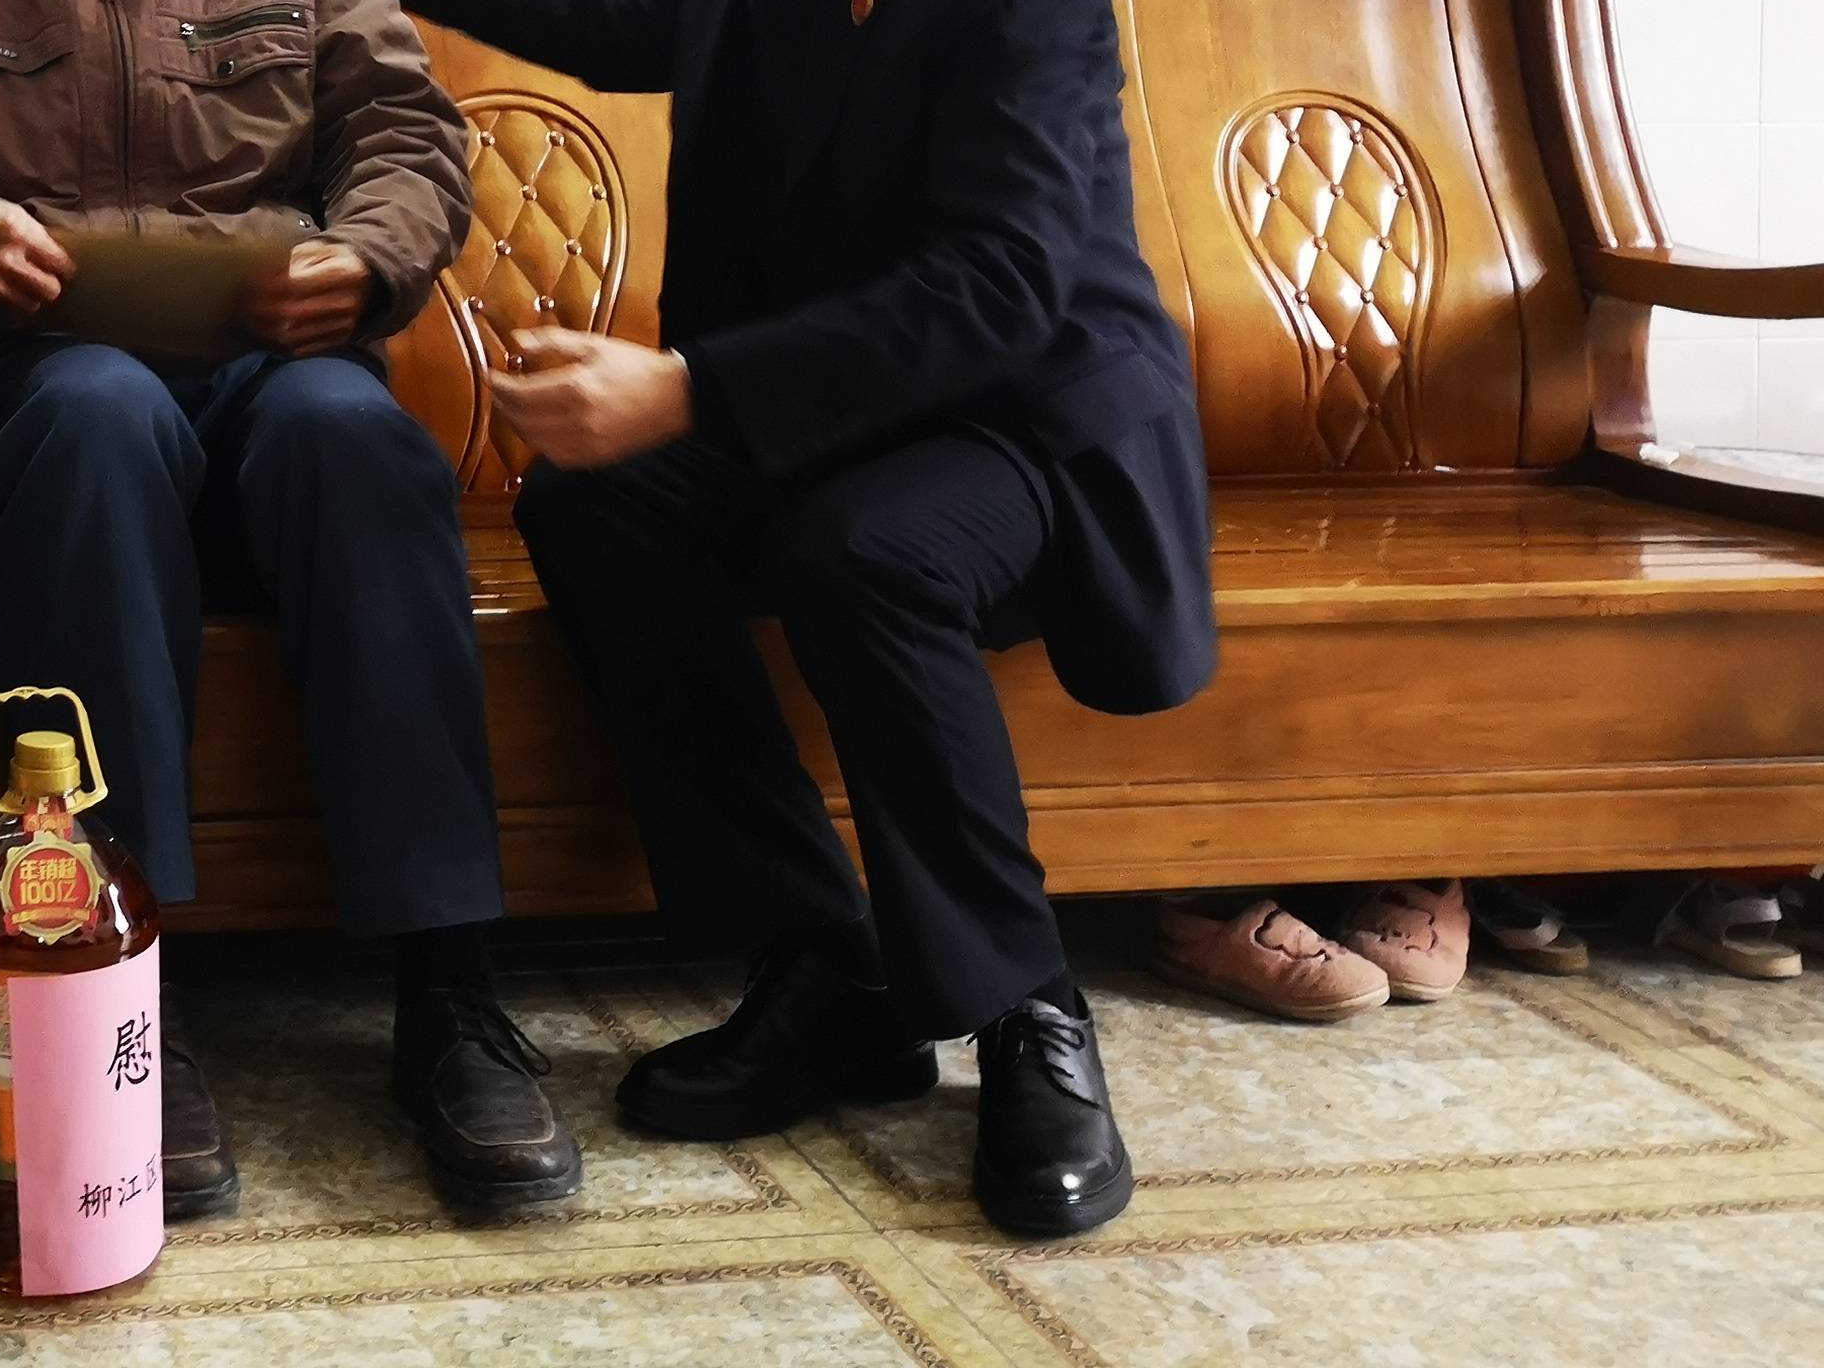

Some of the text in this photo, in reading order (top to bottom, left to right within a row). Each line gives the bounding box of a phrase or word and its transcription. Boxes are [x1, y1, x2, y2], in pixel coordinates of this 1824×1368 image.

[19, 857, 78, 881] 年销超
[19, 881, 79, 905] 100亿
[106, 1011, 152, 1091] 慰
